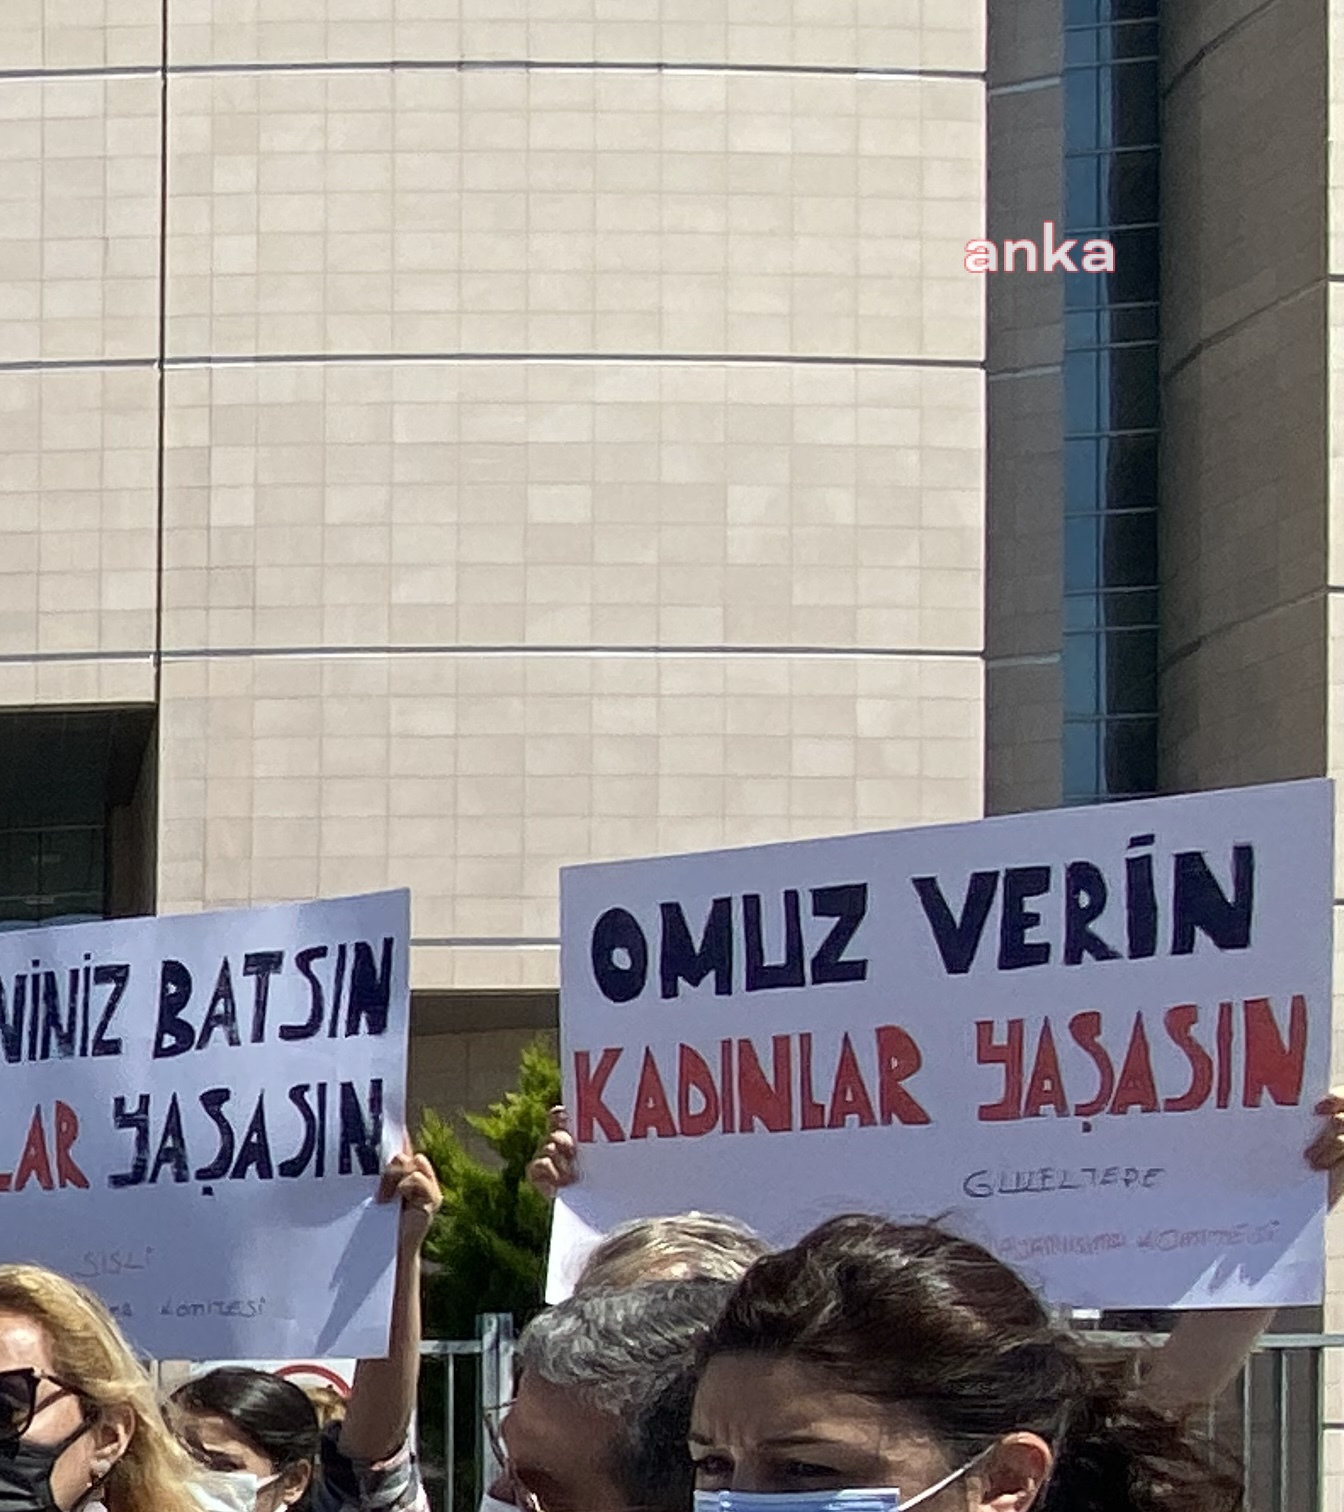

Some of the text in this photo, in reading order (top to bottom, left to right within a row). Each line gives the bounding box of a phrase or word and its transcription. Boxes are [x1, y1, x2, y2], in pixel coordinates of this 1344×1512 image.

[591, 833, 1256, 1002] OMUZ VERİN
[153, 937, 395, 1059] BATSIN
[108, 1078, 385, 1196] YAŞASIN
[574, 995, 1309, 1144] KADINLAR YAŞASIN
